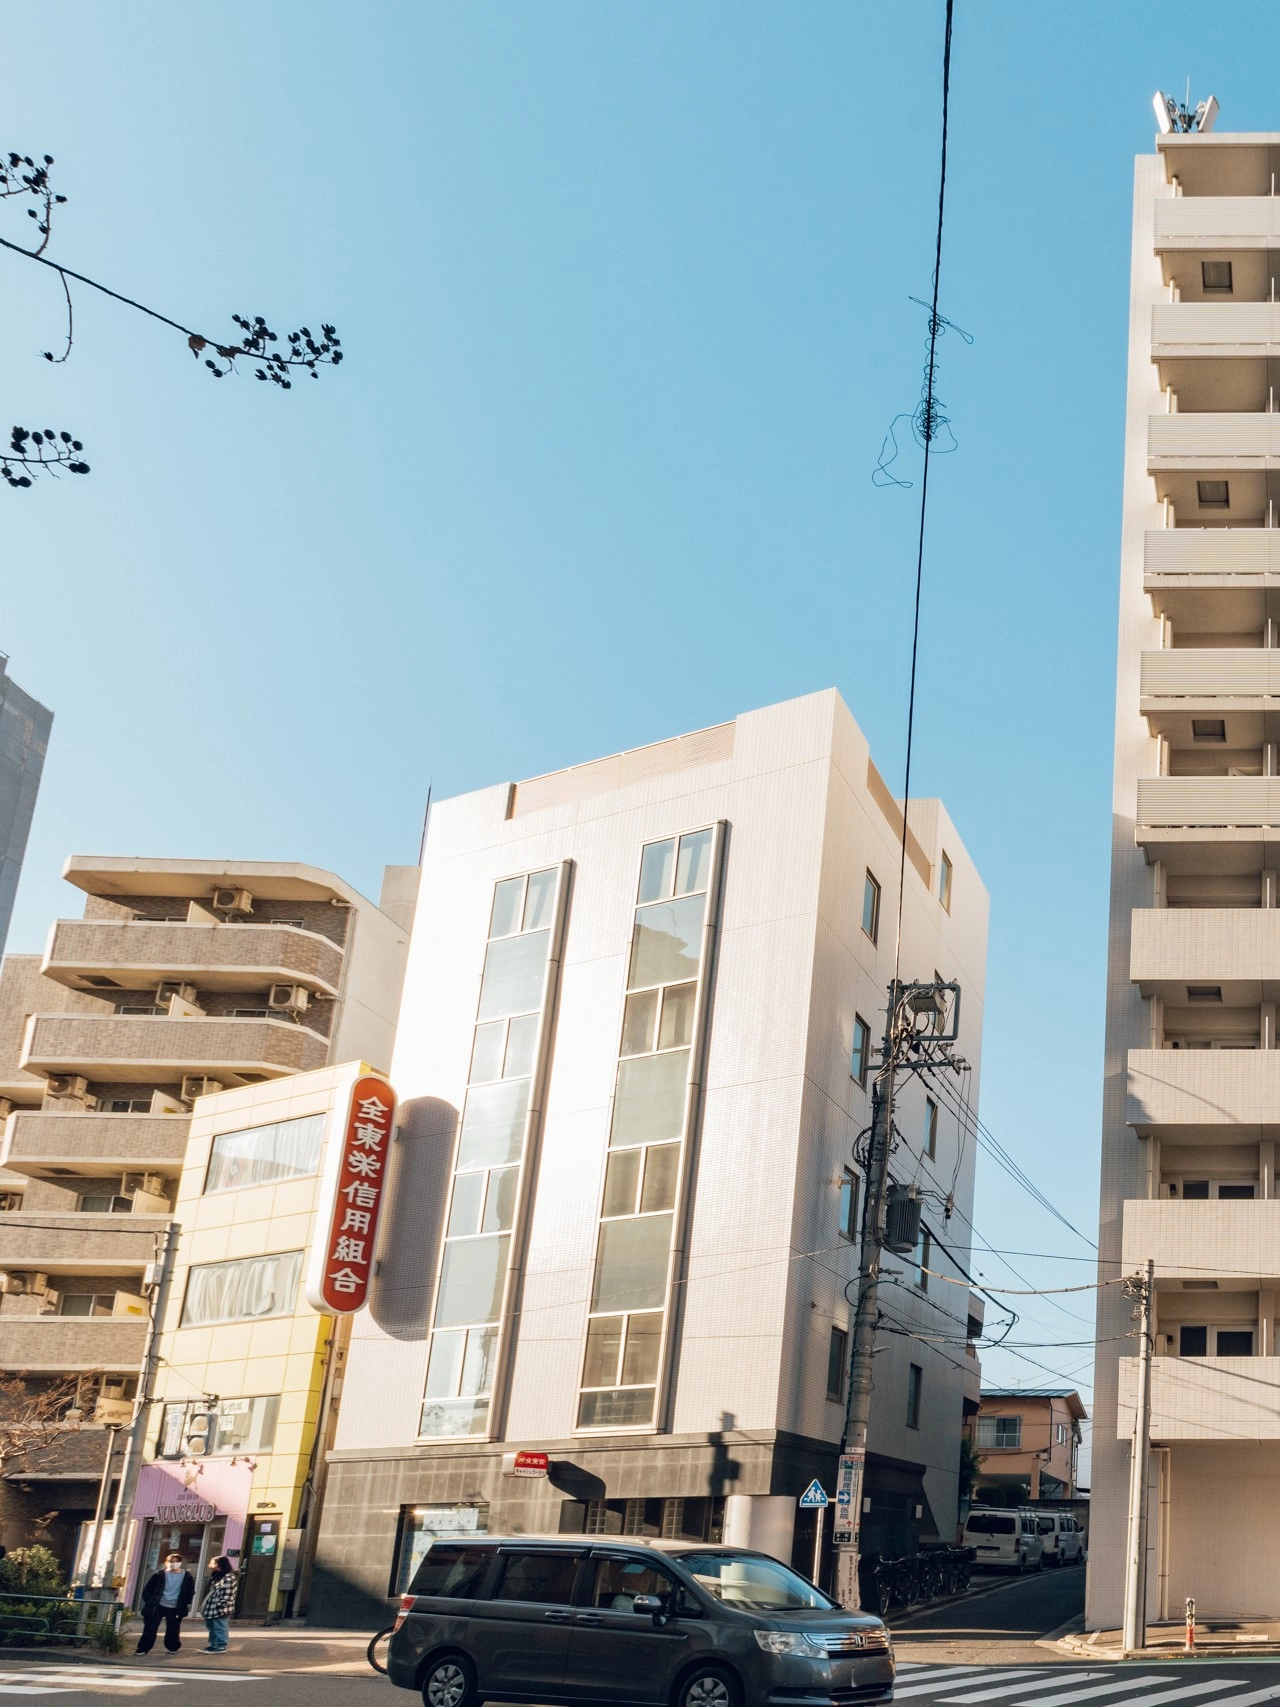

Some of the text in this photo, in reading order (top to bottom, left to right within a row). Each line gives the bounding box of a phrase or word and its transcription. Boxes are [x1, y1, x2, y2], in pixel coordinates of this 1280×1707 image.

[329, 1096, 389, 1293] 全東栄信用組合
